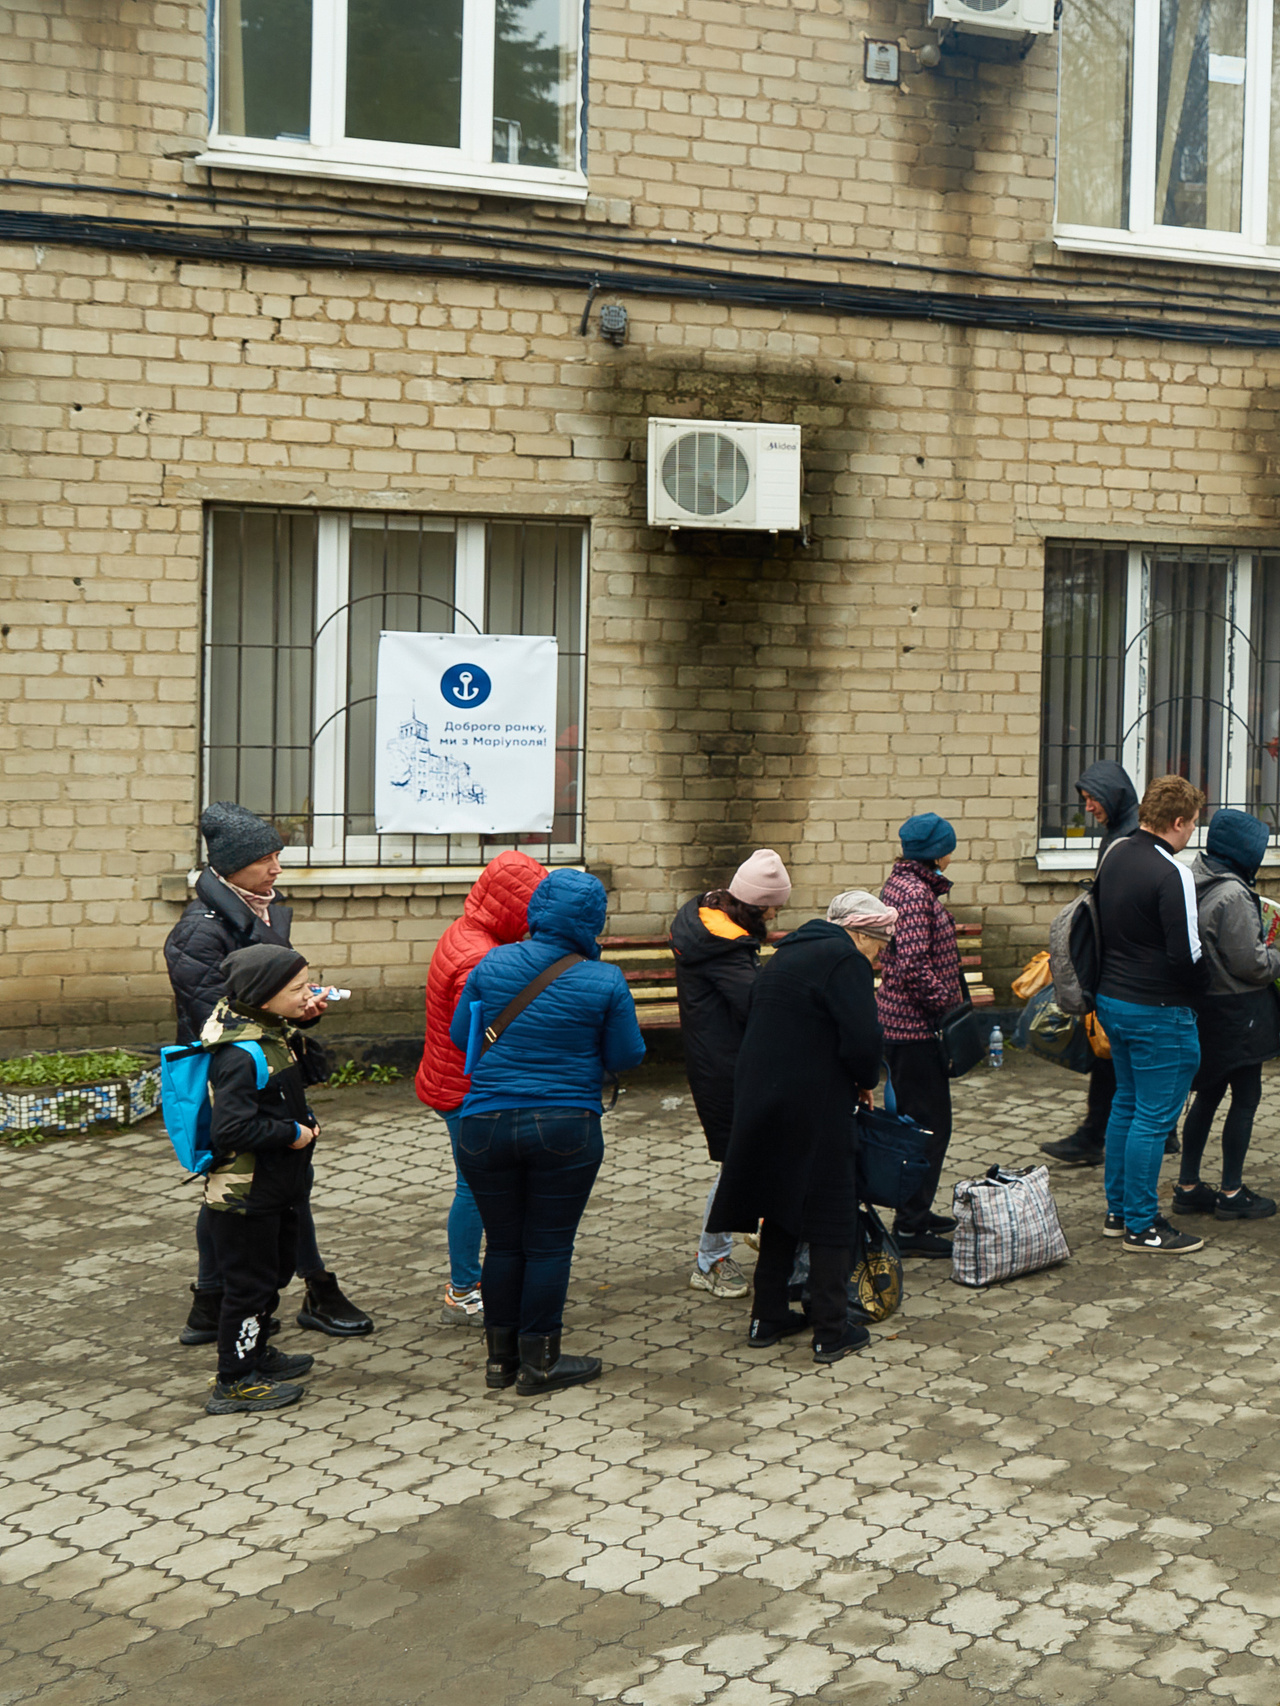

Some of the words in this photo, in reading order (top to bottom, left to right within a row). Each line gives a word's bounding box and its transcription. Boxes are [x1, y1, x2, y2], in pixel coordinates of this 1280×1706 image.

[768, 441, 797, 450] Midea
[444, 721, 501, 734] Доброго
[505, 724, 547, 734] ранку,
[440, 738, 457, 746] ми
[473, 737, 547, 748] Маріуполя!
